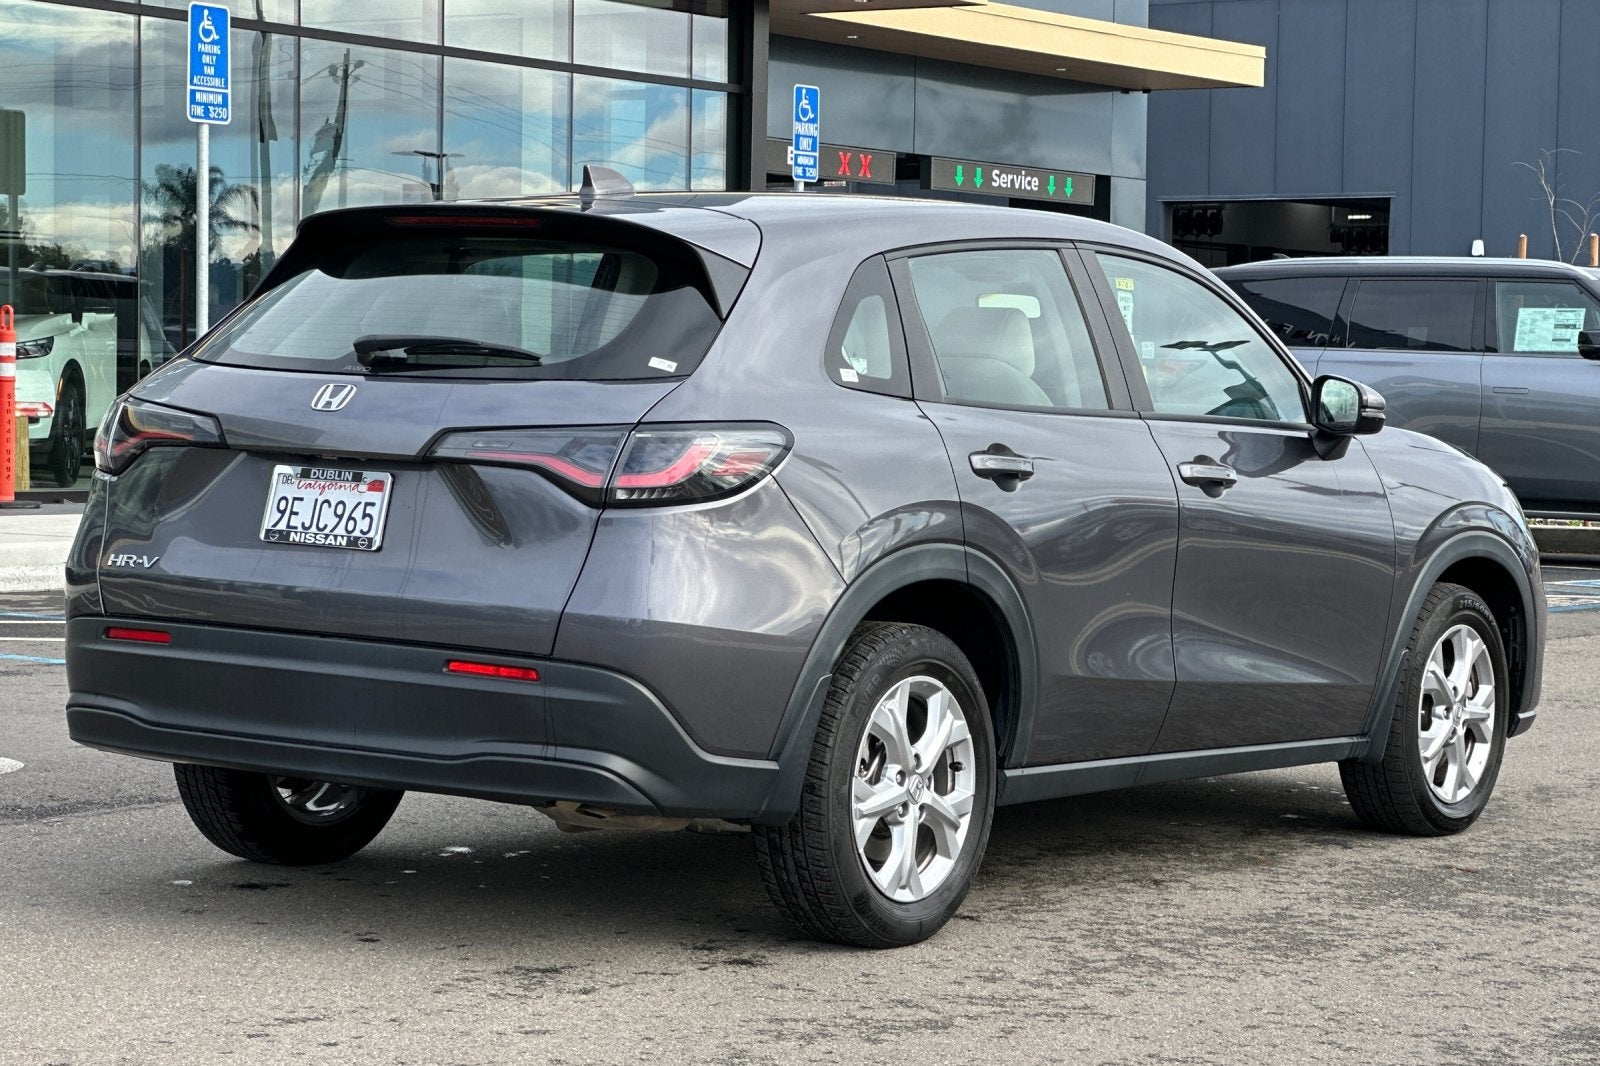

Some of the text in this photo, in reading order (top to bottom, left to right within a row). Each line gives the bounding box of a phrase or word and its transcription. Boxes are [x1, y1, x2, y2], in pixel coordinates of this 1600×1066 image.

[198, 43, 221, 55] PARKING
[202, 54, 217, 65] ONLY
[203, 65, 215, 75] VAN
[193, 75, 225, 88] ACCESSIBLE
[195, 91, 223, 105] MINIMUM
[191, 104, 205, 117] FINE
[795, 122, 818, 137] PARKING
[799, 136, 813, 151] ONLY
[991, 169, 1039, 191] Service
[310, 469, 353, 481] DUBLIN
[296, 479, 367, 496] California
[271, 496, 376, 536] 9EJC965
[289, 531, 348, 546] NISSAN
[107, 553, 160, 568] HR-V
